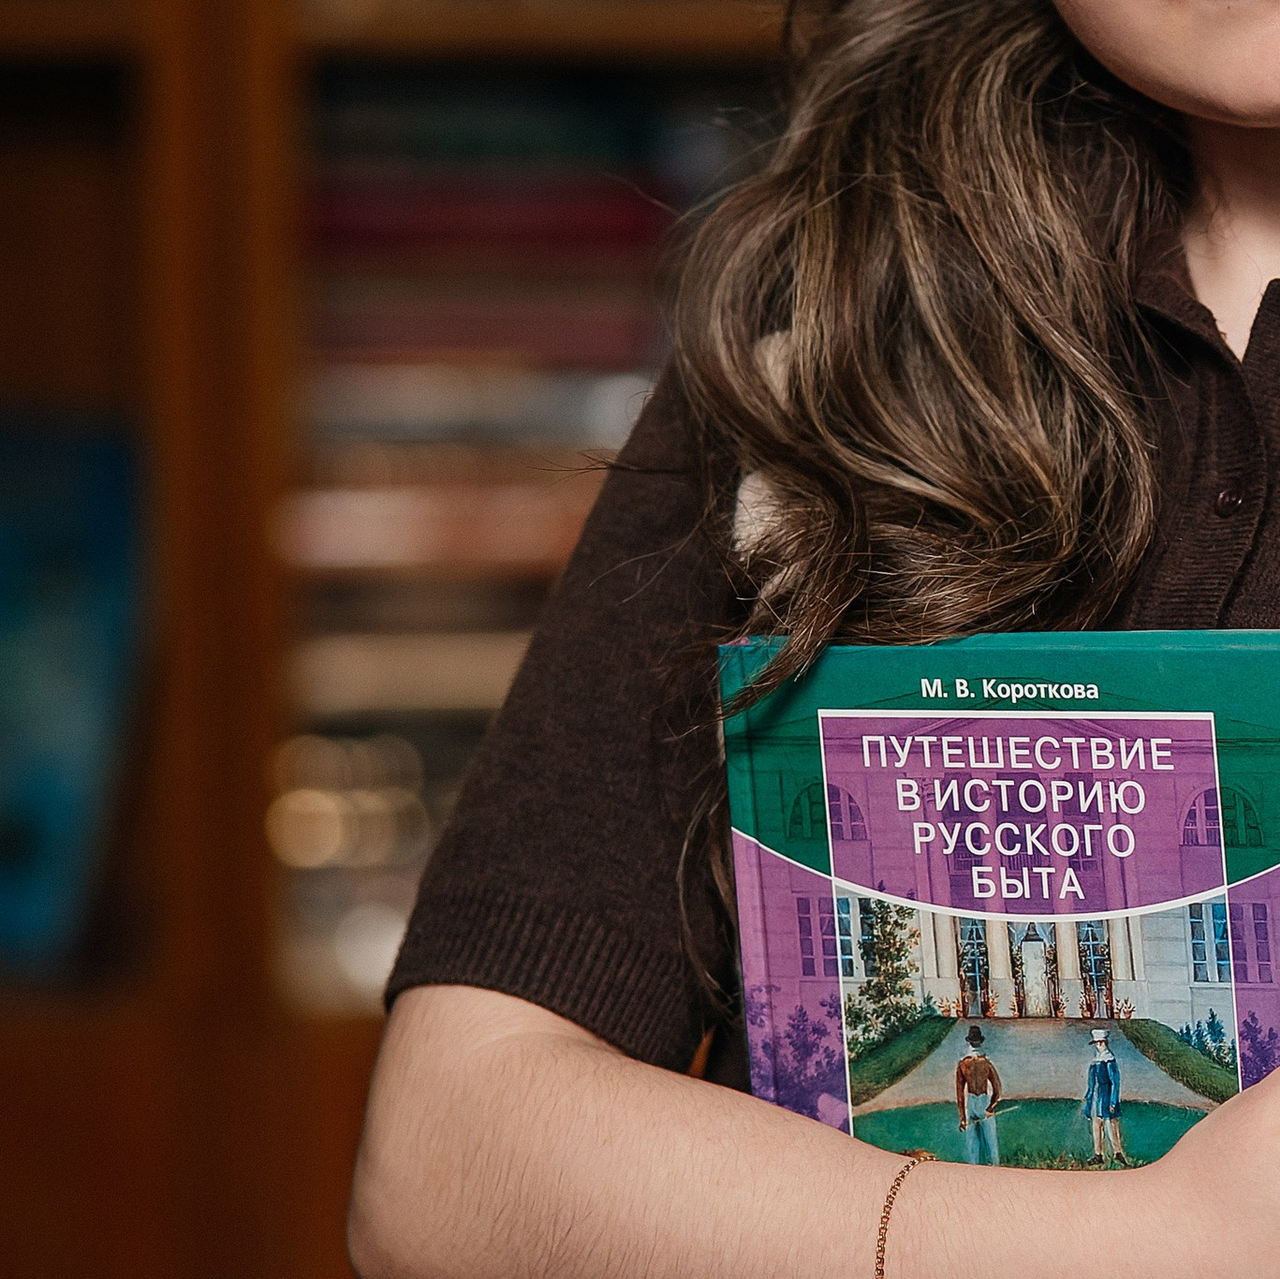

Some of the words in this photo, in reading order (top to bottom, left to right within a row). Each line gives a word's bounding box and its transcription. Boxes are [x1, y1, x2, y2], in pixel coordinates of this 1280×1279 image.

[920, 678, 948, 699] М.
[955, 678, 975, 699] В.
[982, 678, 1099, 704] Короткова
[861, 734, 1175, 771] ПУТЕШЕСТВИЕ
[895, 777, 921, 812] В
[933, 778, 1146, 814] ИСТОРИЮ
[912, 820, 1136, 858] РУССКОГО
[971, 865, 1085, 900] БЫТА
